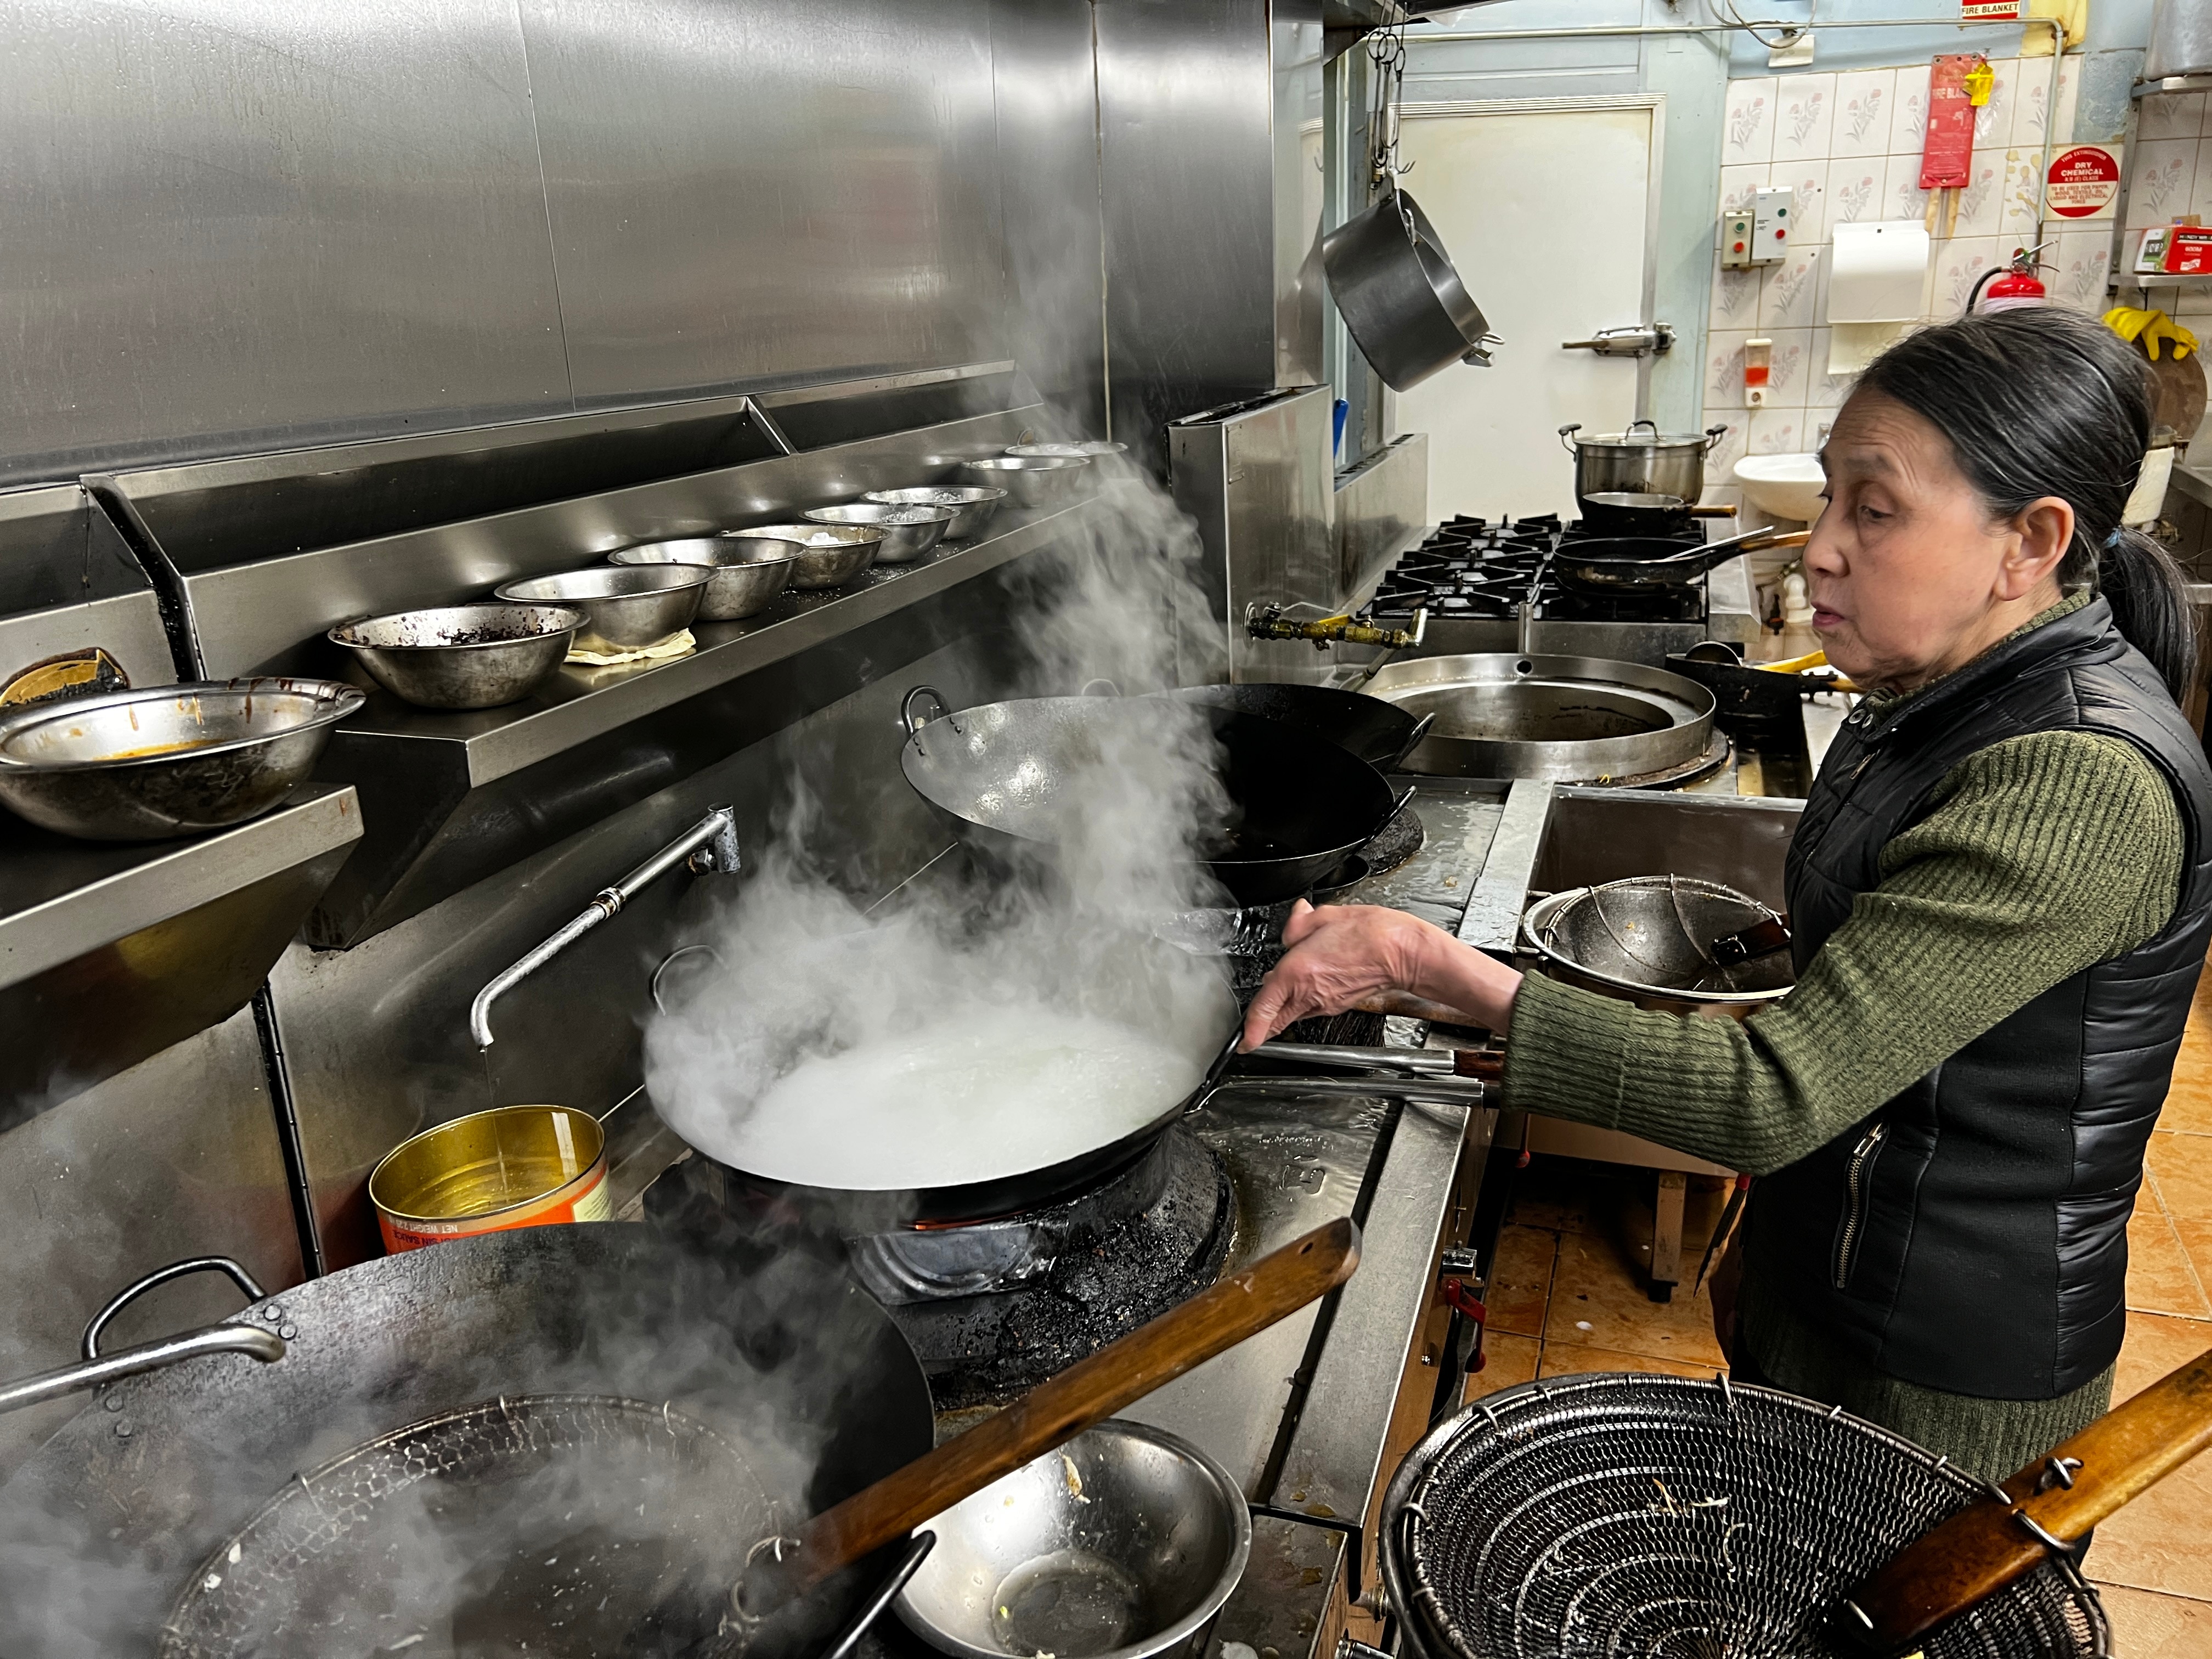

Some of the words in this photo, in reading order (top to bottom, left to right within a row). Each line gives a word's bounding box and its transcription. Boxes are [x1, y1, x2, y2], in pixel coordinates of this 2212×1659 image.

[1982, 3, 2019, 13] BLANKET
[2061, 154, 2073, 162] THIS
[2074, 150, 2107, 161] EXTINGUISHER
[410, 1223, 438, 1234] WEIGHT
[442, 1224, 458, 1233] NET
[393, 1230, 420, 1244] SAUCE
